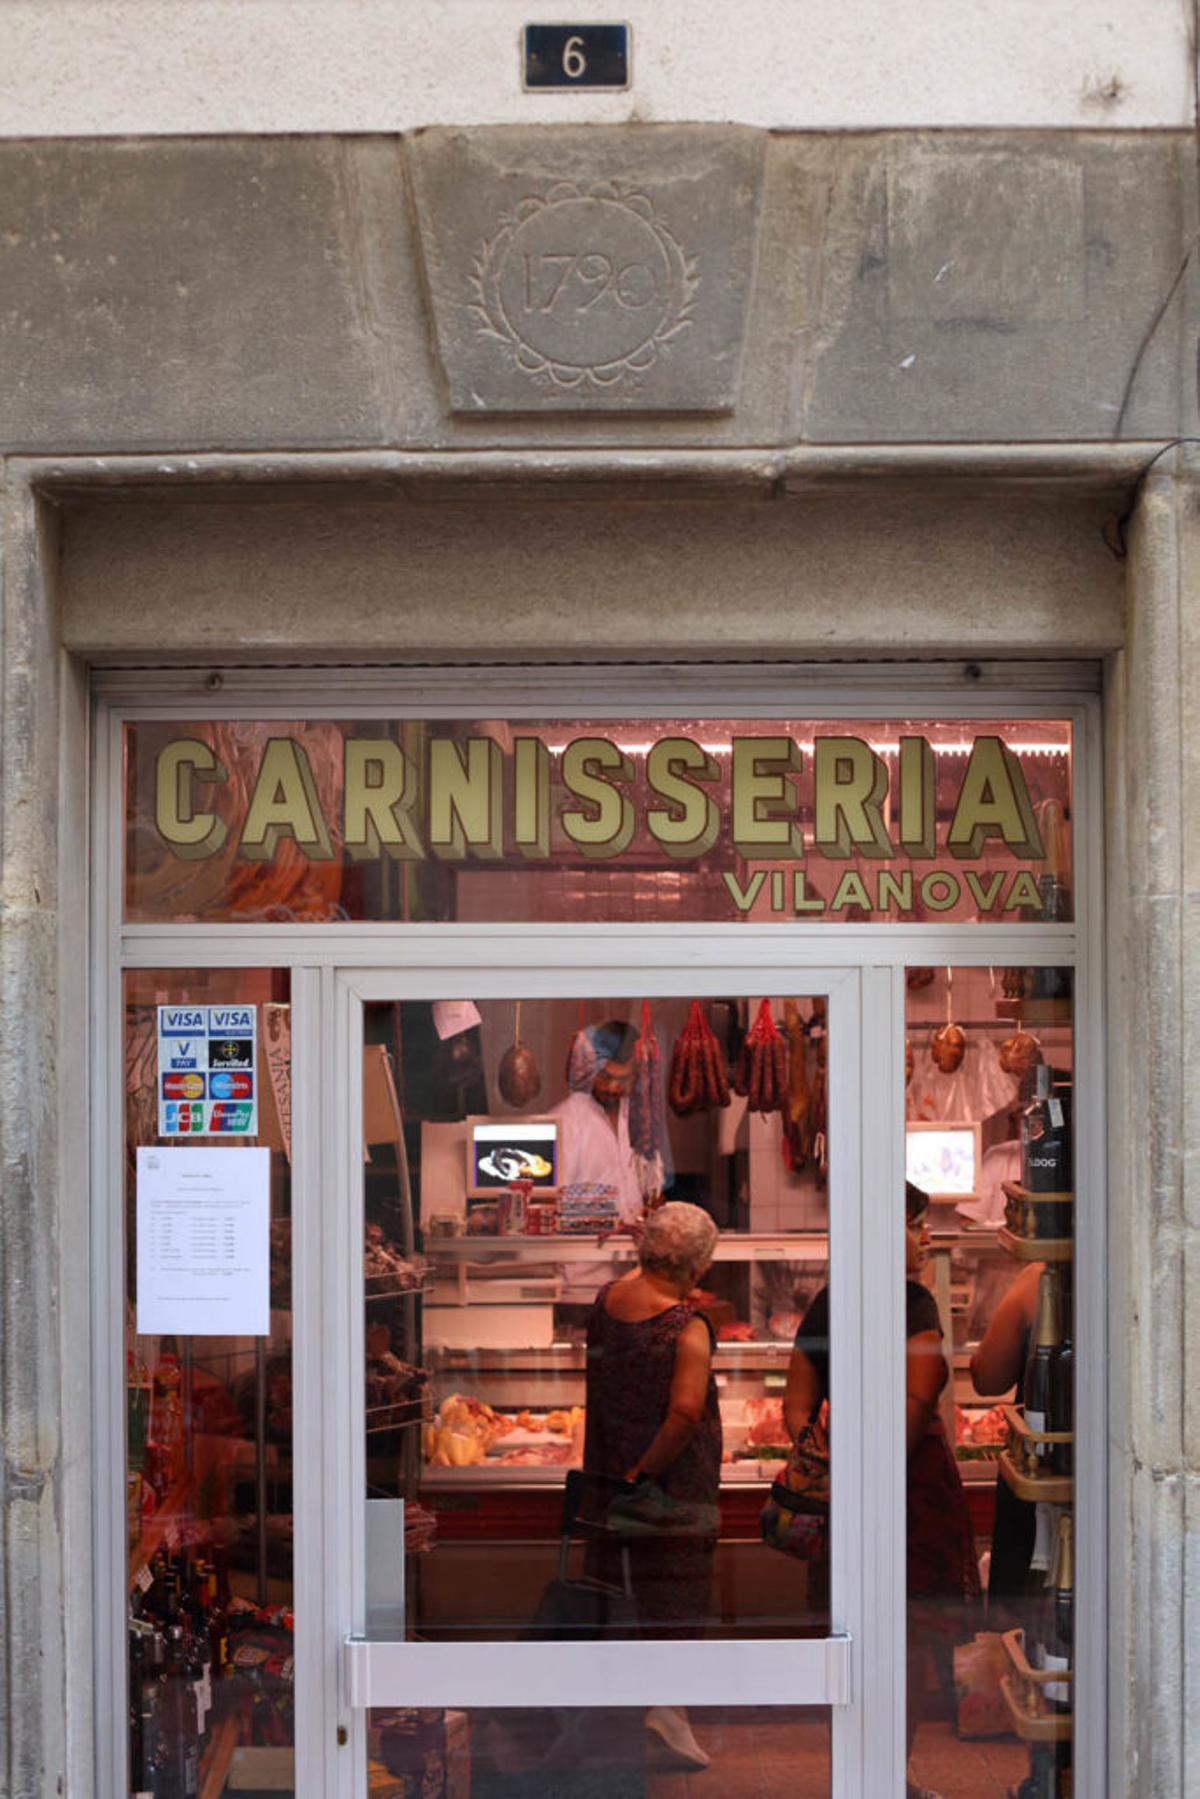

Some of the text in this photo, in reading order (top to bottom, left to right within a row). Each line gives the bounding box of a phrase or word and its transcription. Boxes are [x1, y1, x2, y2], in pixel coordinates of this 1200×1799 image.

[562, 36, 587, 77] 6
[521, 253, 657, 314] 1790
[154, 736, 1046, 861] CARNISSERIA
[722, 870, 1045, 912] VILANOVA
[167, 1012, 203, 1026] VISA
[213, 1012, 250, 1026] VISA
[166, 1111, 203, 1123] JCB
